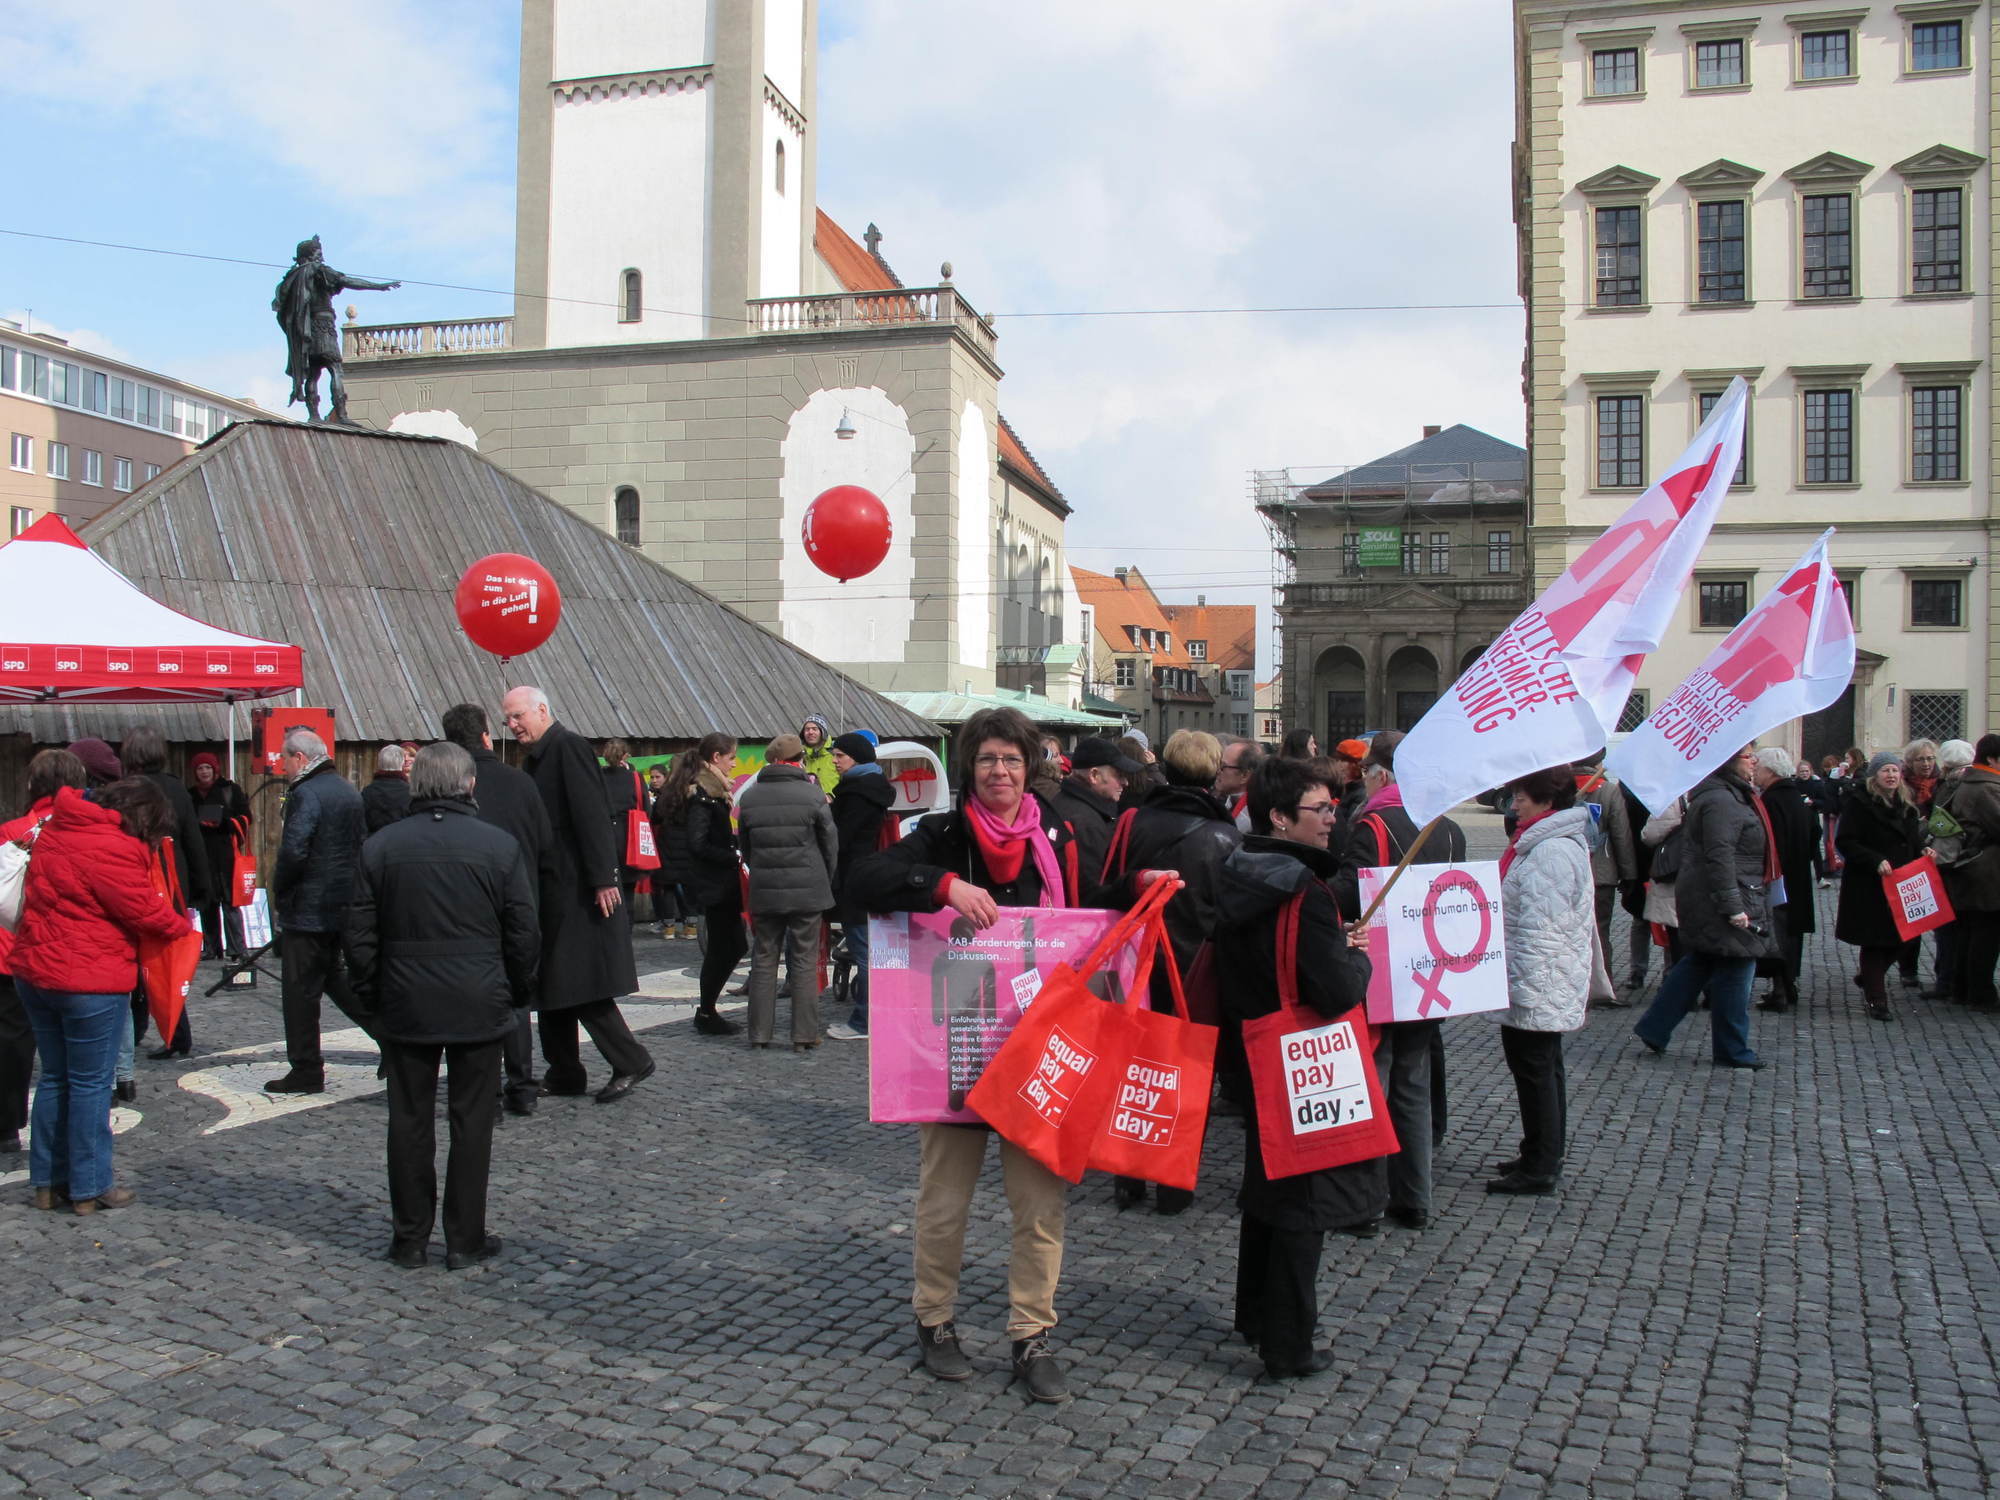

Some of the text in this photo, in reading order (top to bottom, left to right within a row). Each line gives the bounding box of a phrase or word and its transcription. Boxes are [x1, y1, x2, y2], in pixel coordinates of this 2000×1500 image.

[504, 576, 516, 584] ist
[518, 577, 538, 586] doch
[481, 592, 528, 607] in die Luft
[501, 603, 530, 616] gehen
[3, 661, 25, 670] SPD
[57, 661, 78, 671] SPD
[108, 662, 129, 671] SPD
[159, 663, 179, 672] SPD
[207, 664, 228, 673] SPD
[255, 664, 275, 673] SPD
[1428, 877, 1479, 896] Equal pay
[1900, 874, 1927, 894] equal
[1903, 891, 1922, 906] pay
[1402, 904, 1432, 922] Equal
[1434, 902, 1469, 916] human
[1471, 898, 1499, 914] being
[947, 937, 1066, 950] KAB-Forderungen für die
[947, 951, 1010, 961] Diskussion...
[1411, 951, 1461, 971] Leiharbeit
[1463, 950, 1503, 967] stoppen
[1013, 970, 1039, 990] equal
[1016, 986, 1033, 1003] pay
[950, 1015, 986, 1025] Einführung
[1287, 1025, 1352, 1063] equal
[1048, 1033, 1094, 1076] equal
[1039, 1052, 1066, 1085] pay
[1126, 1063, 1178, 1091] equal
[1291, 1062, 1335, 1095] pay
[1120, 1083, 1161, 1112] pay
